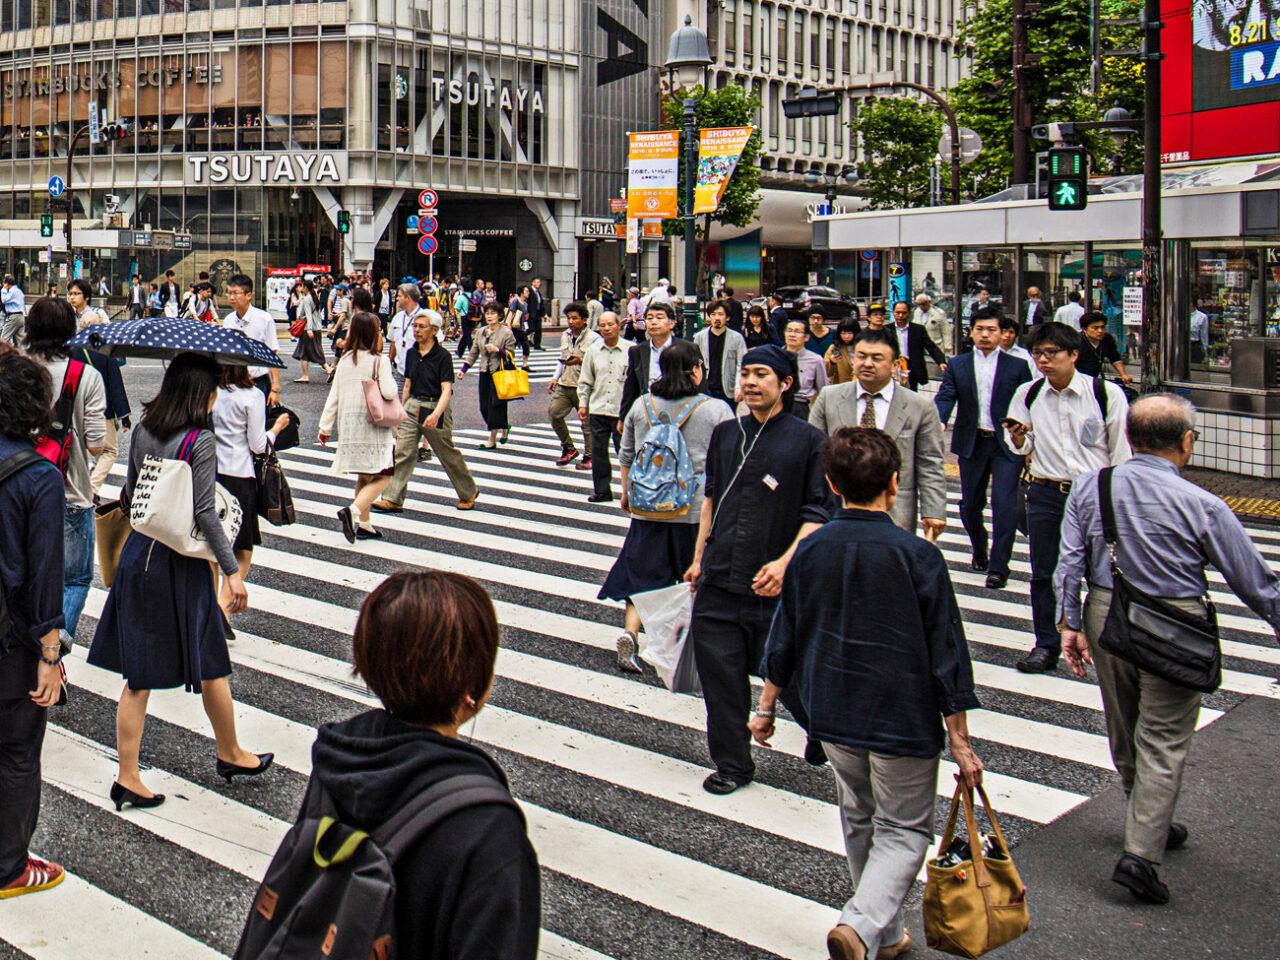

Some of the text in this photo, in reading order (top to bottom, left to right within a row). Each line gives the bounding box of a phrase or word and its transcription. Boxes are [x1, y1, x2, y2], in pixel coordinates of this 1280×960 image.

[1230, 19, 1267, 46] 8.21
[4, 64, 223, 99] STARBUCKS COFFEE
[431, 76, 545, 114] TSUTAYA
[635, 133, 673, 141] SHIBUYA
[706, 129, 747, 138] SHIBUYA
[631, 140, 678, 149] RENAISSANCE
[188, 153, 341, 183] TSUTAYA
[891, 266, 898, 275] 7
